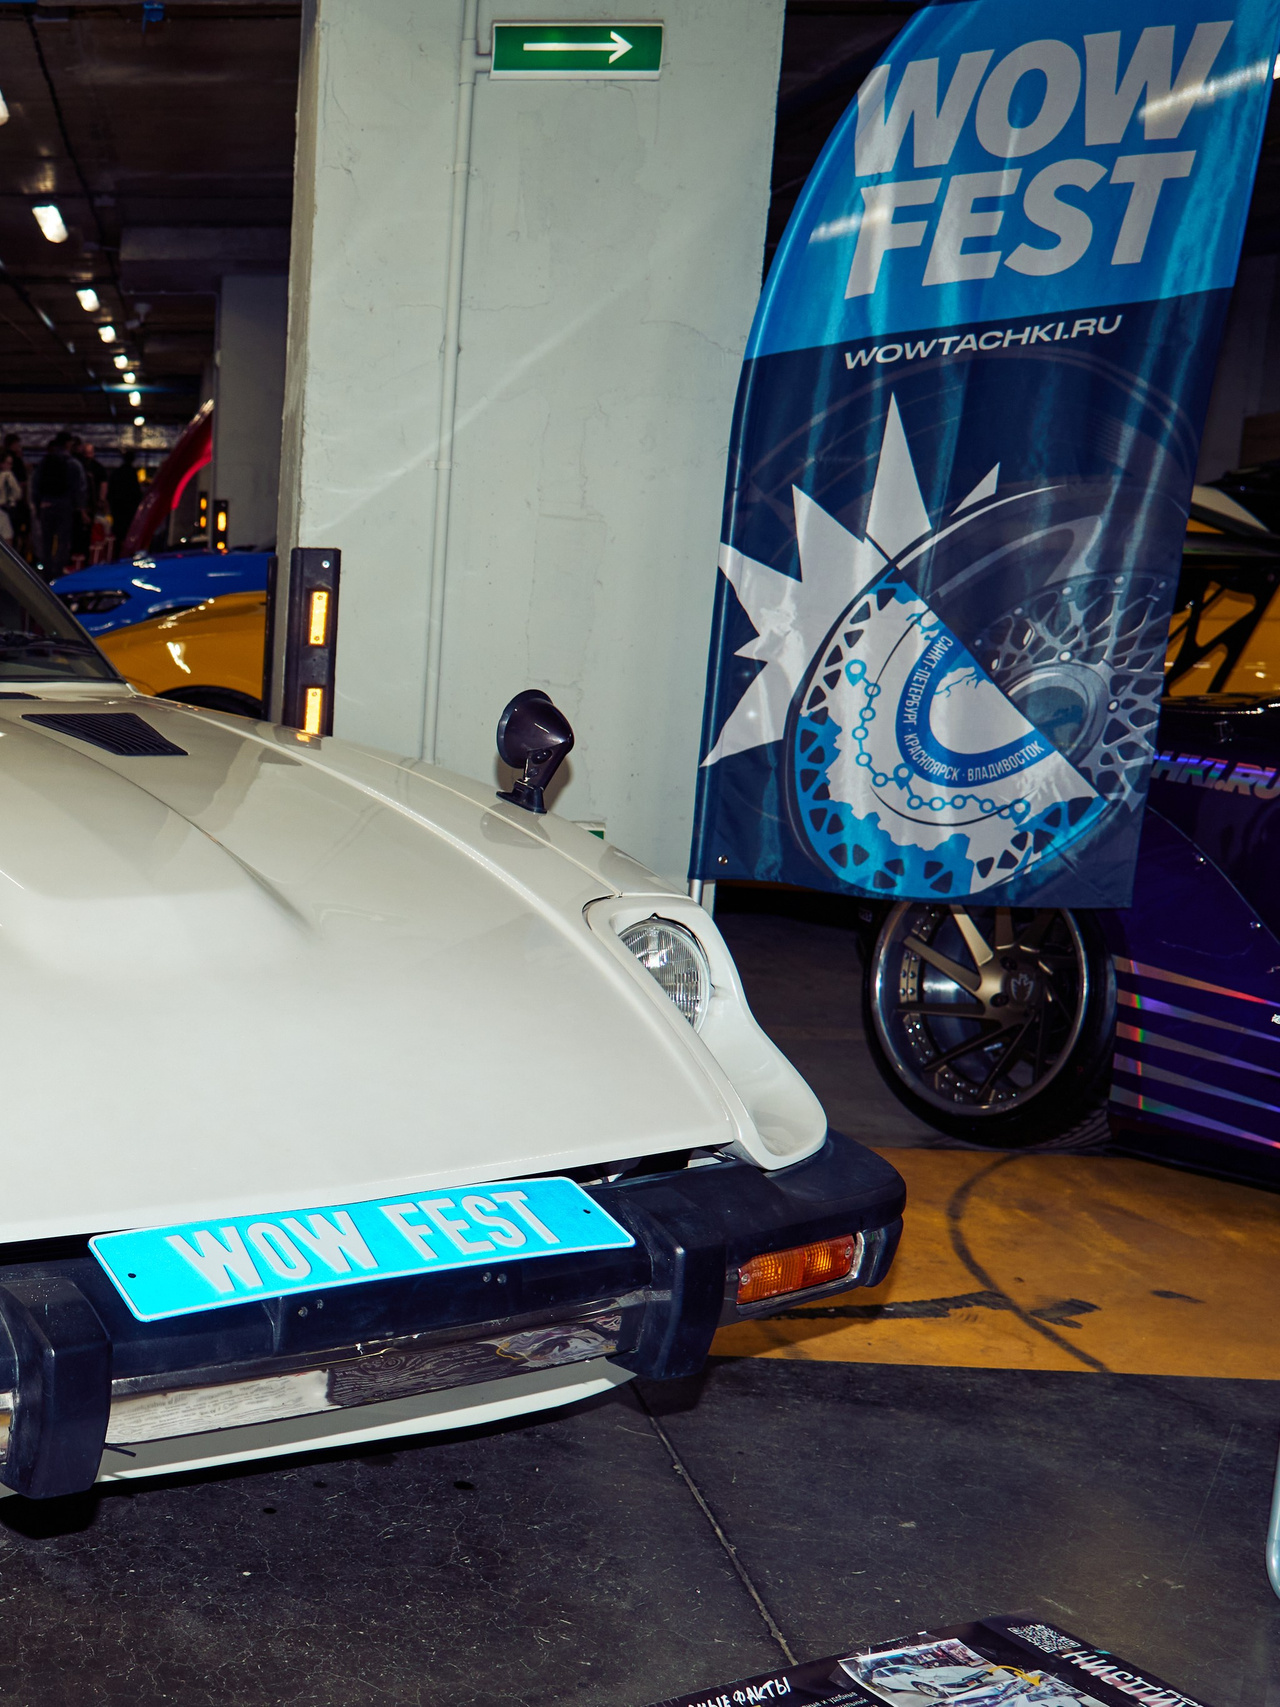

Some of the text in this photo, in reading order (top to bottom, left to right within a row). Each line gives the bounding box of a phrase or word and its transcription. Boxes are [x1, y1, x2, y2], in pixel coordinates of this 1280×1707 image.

[854, 20, 1233, 177] WOW
[844, 150, 1196, 299] FEST
[845, 315, 1123, 370] WOWTACHKI.RU
[903, 635, 1046, 782] САНКТ-ПЕТЕРБУРГ КРАСНОЯРСК ВЛАДИВОСТОК
[1151, 750, 1280, 800] HKI.RU
[167, 1191, 561, 1293] WOW FEST
[733, 1677, 791, 1705] ФАКТЫ
